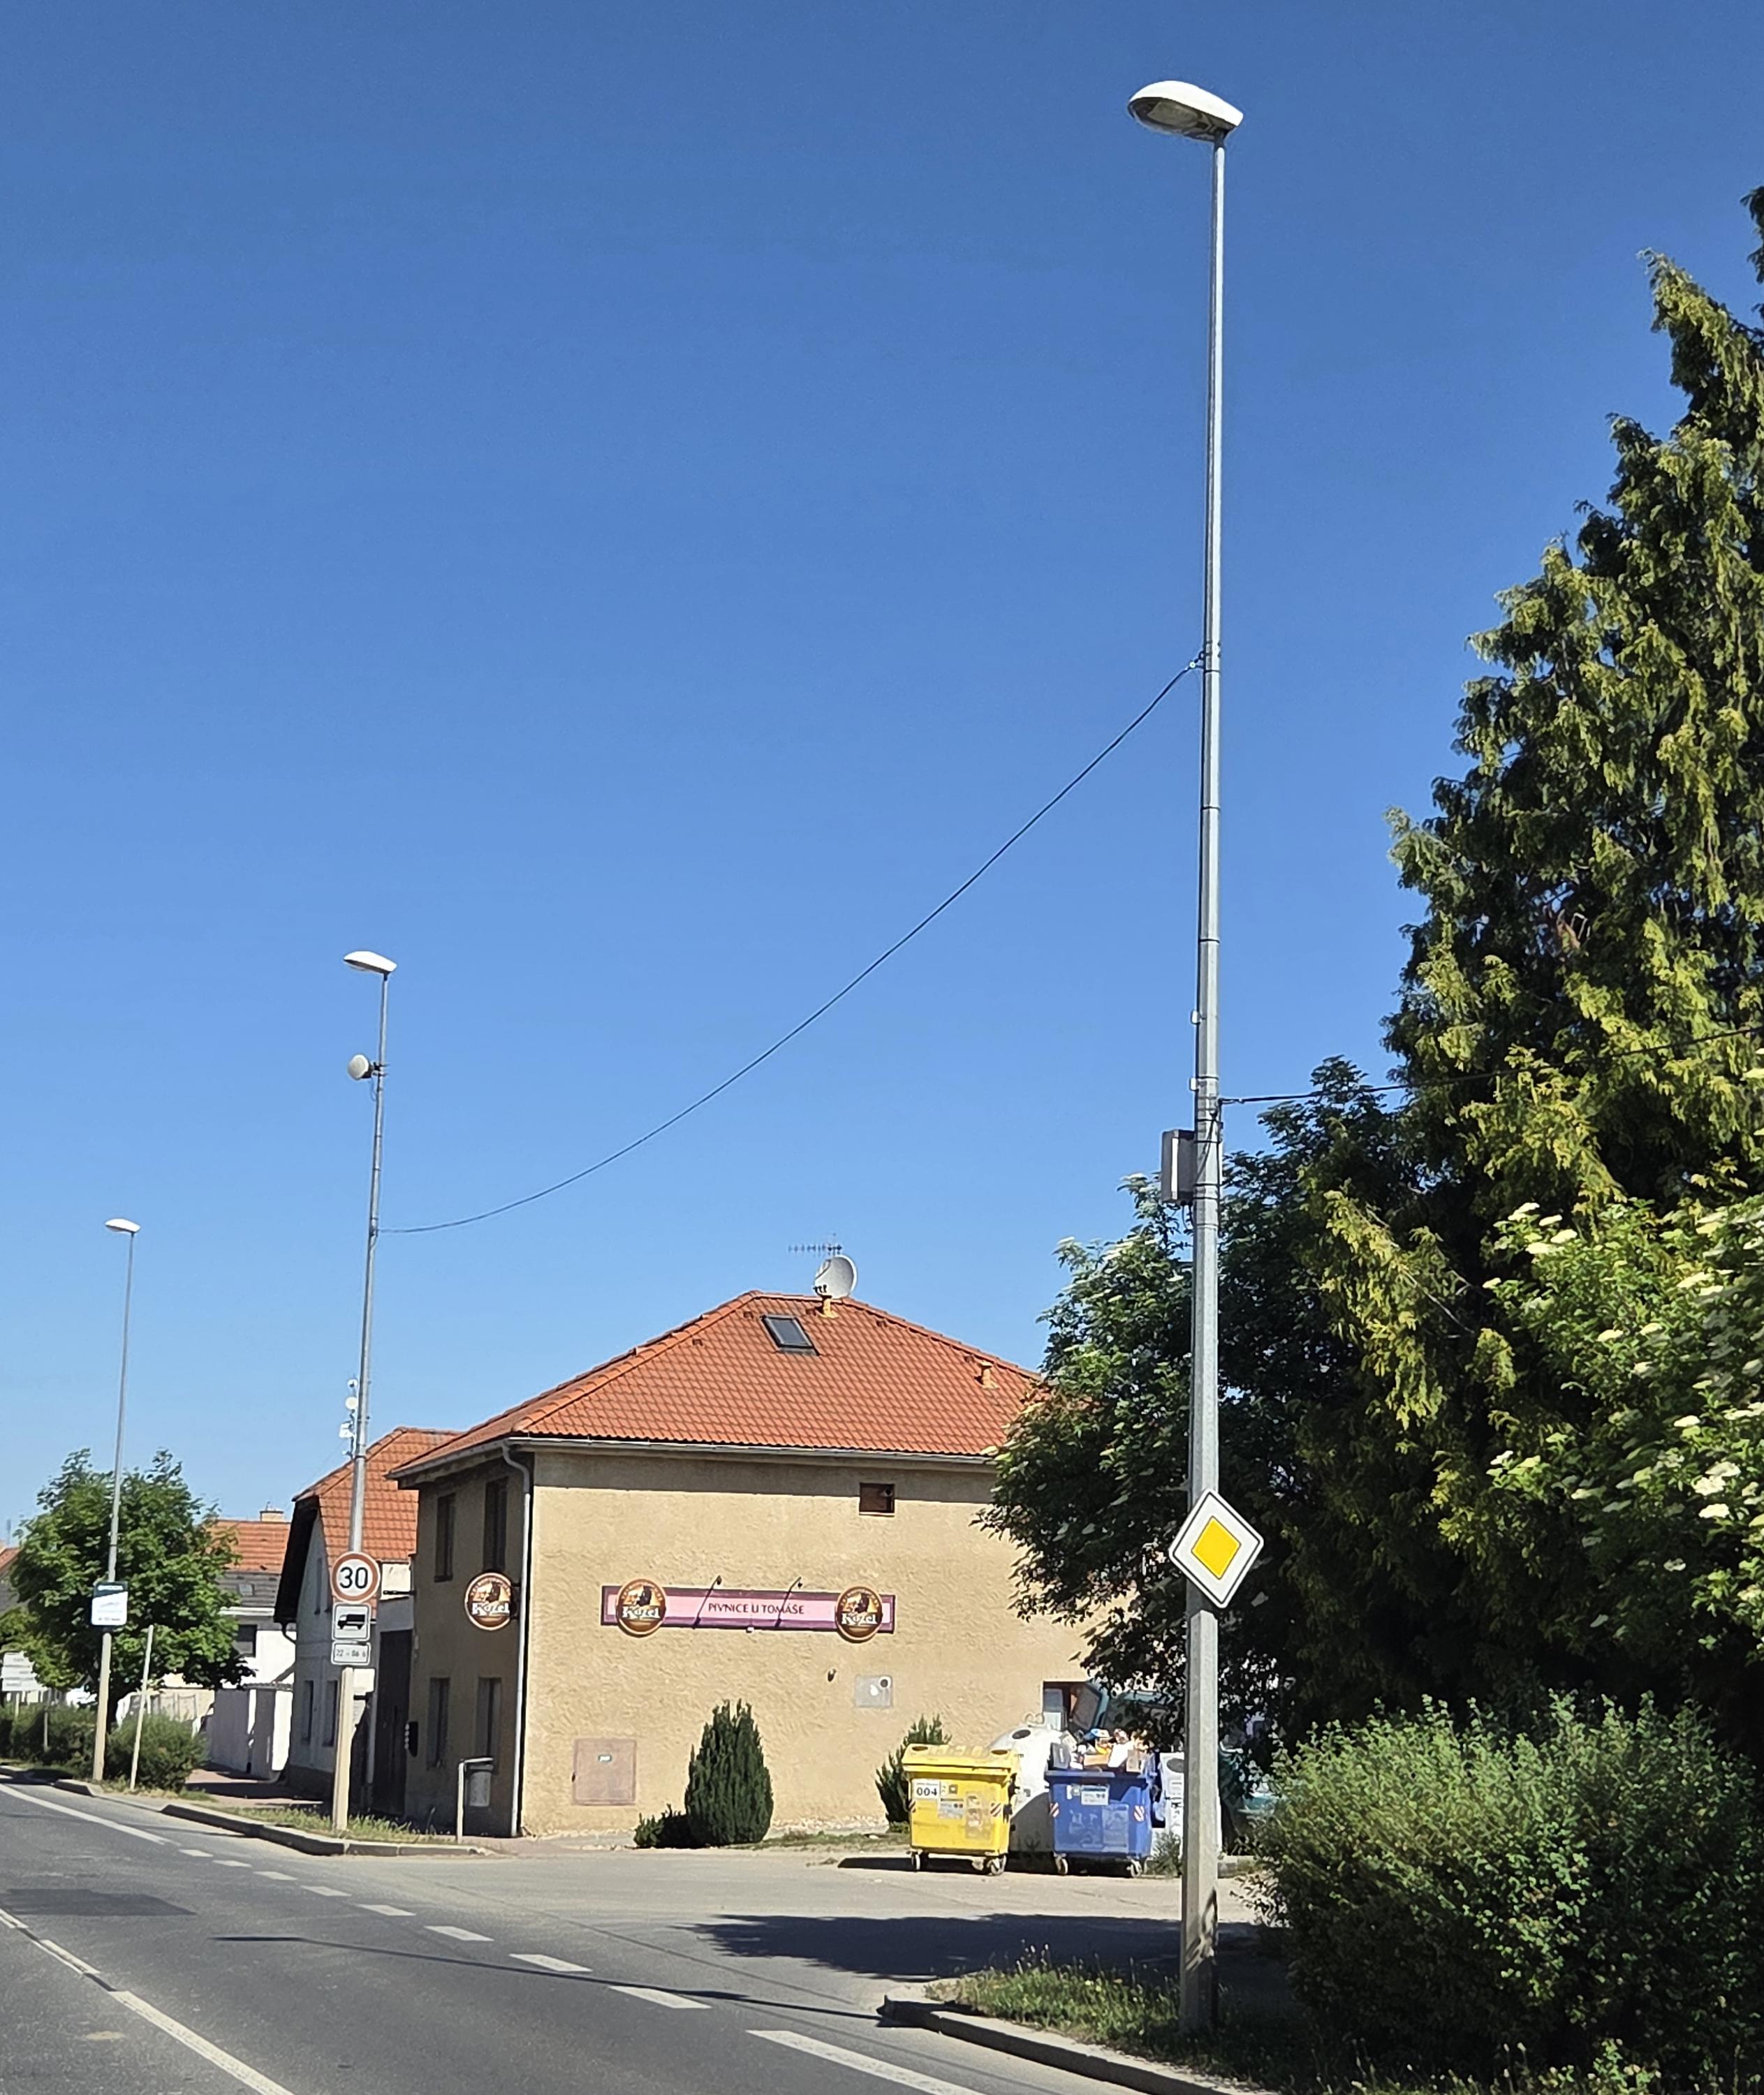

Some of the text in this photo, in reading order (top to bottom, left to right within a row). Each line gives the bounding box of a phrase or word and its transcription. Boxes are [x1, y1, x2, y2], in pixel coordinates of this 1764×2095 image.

[339, 1566, 369, 1589] 30
[472, 1602, 510, 1616] Kozel
[708, 1603, 749, 1613] PIVNICE
[751, 1603, 759, 1613] U
[841, 1612, 878, 1626] Kozel
[916, 1787, 938, 1796] 004
